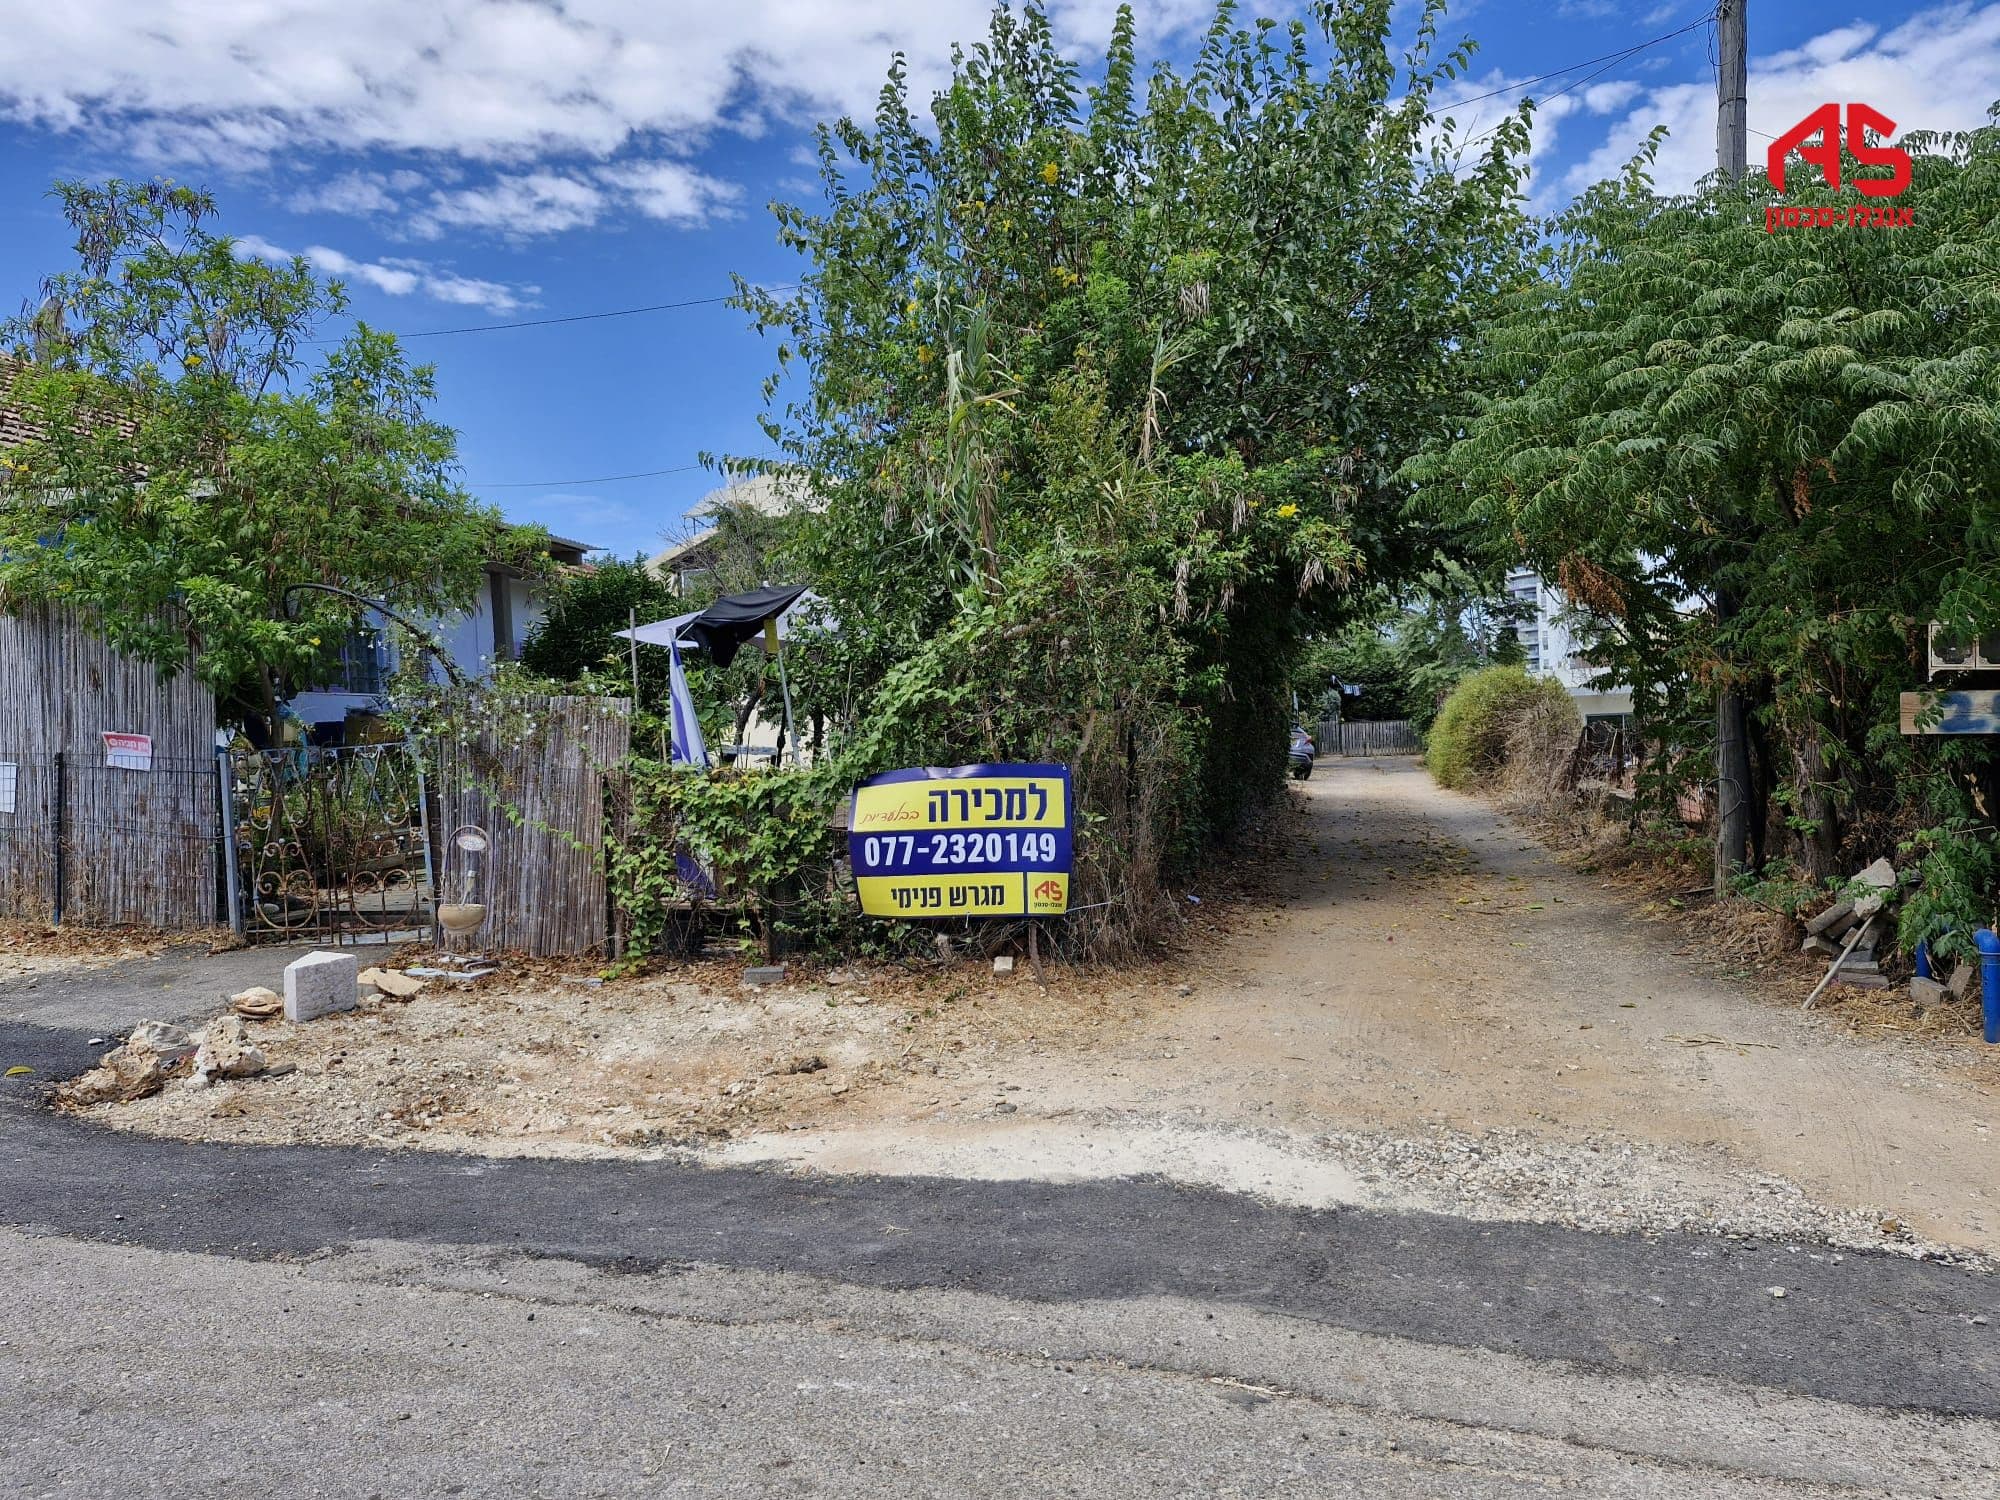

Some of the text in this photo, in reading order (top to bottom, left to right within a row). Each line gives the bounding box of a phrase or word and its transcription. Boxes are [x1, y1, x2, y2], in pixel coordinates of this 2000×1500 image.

[859, 802, 920, 824] בבלעדיות
[928, 783, 1047, 823] למכירה
[864, 833, 1056, 867] 077-2320149
[891, 884, 1005, 908] מגרש פנימי
[1034, 880, 1063, 901] AS
